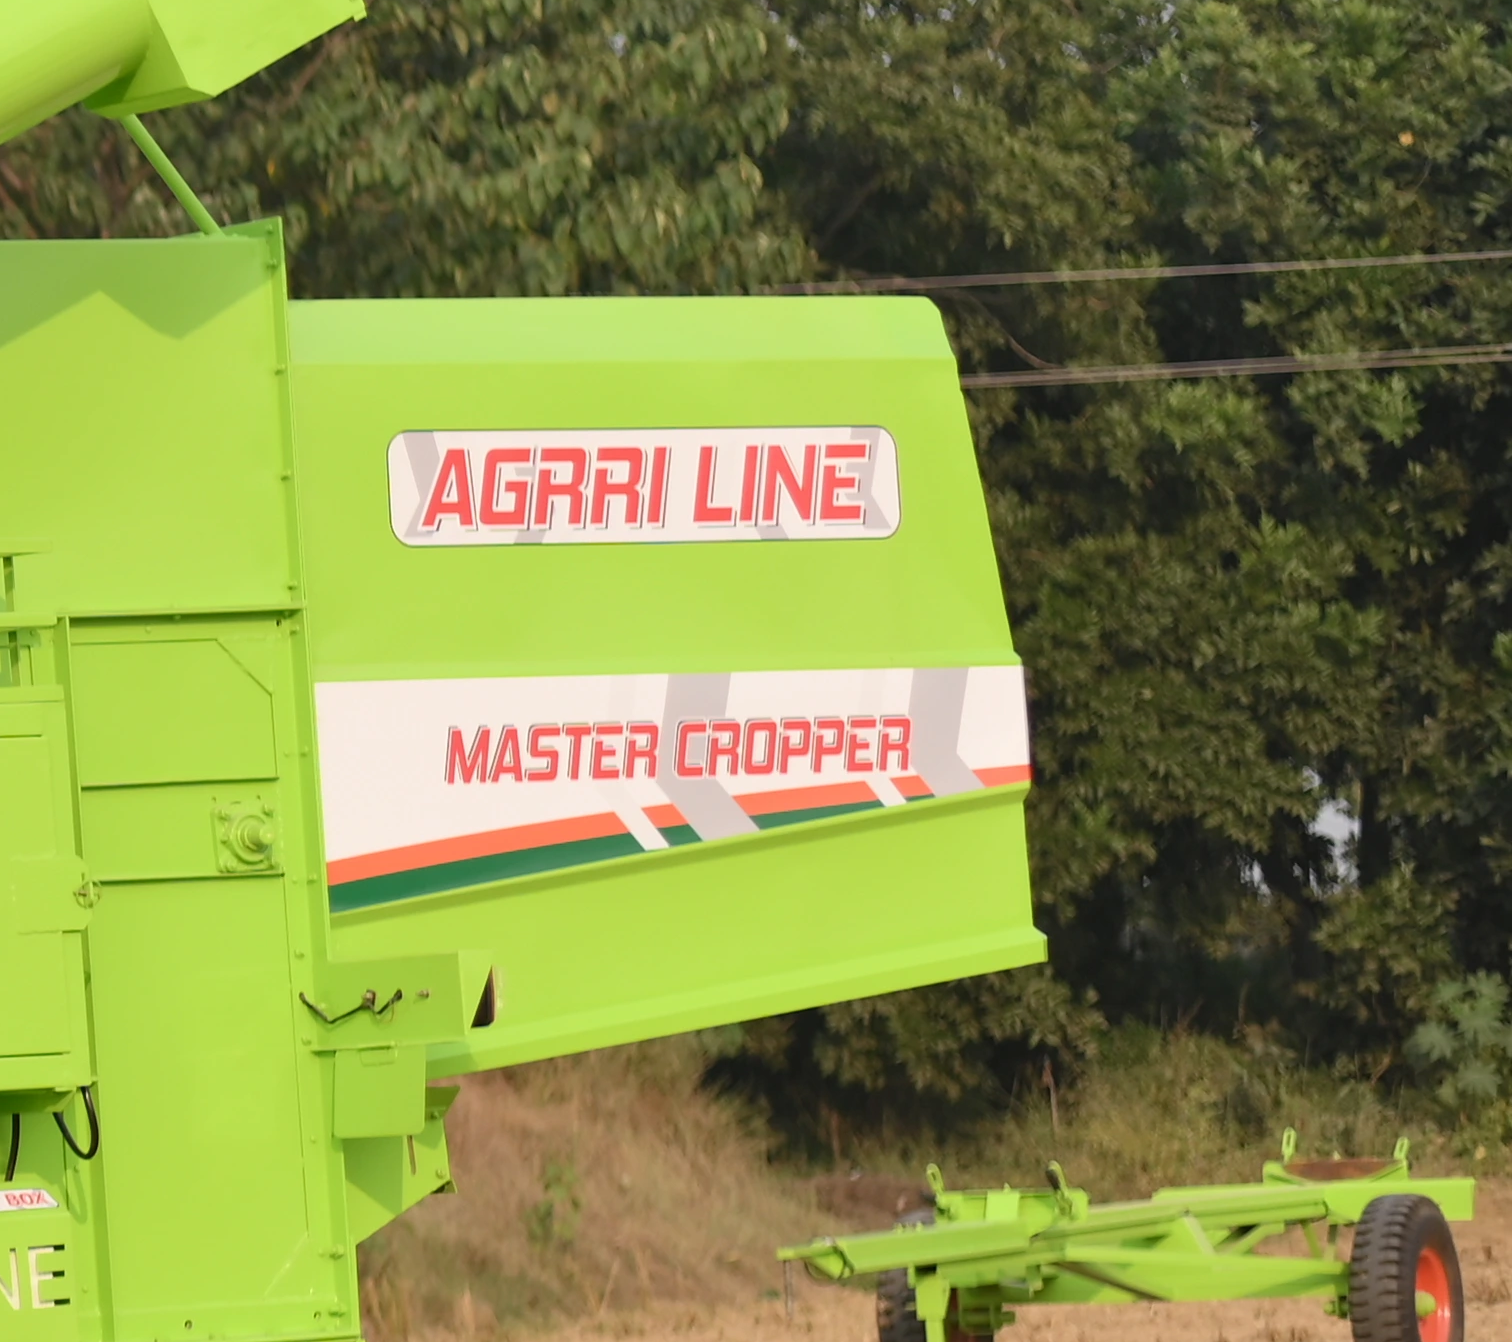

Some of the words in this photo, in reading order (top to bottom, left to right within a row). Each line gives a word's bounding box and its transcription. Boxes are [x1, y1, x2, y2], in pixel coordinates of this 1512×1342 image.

[421, 446, 670, 533] AGRRI
[691, 442, 870, 528] LINE
[445, 719, 661, 785] MASTER
[674, 715, 912, 779] CROPPER
[5, 1191, 49, 1207] BOX
